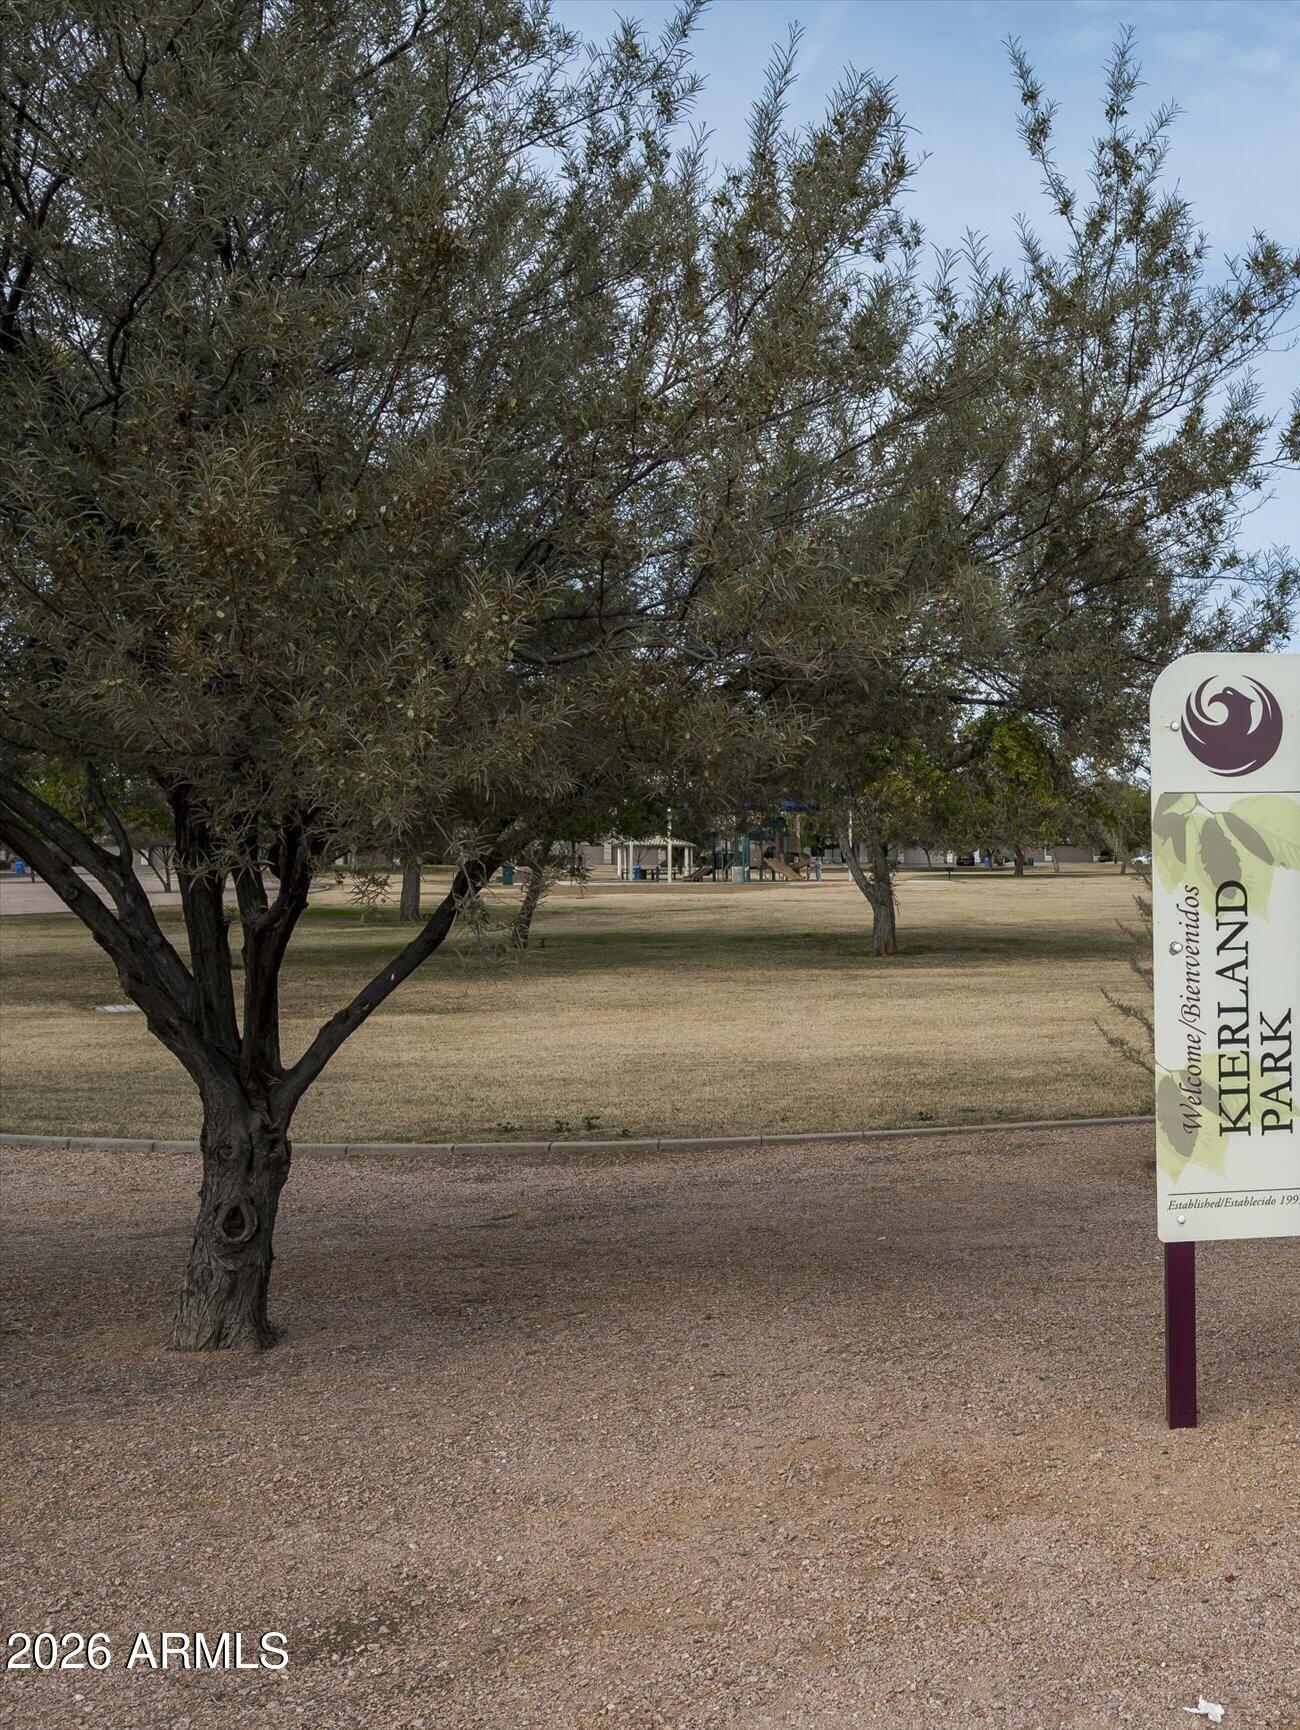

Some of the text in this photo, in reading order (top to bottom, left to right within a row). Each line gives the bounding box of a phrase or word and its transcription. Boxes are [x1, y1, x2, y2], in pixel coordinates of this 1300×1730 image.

[1177, 885, 1206, 1134] Welcome/Bienvenidos
[1215, 880, 1252, 1137] KIERLAND
[1260, 1008, 1294, 1136] PARK
[1167, 1197, 1277, 1211] Established/Establecido
